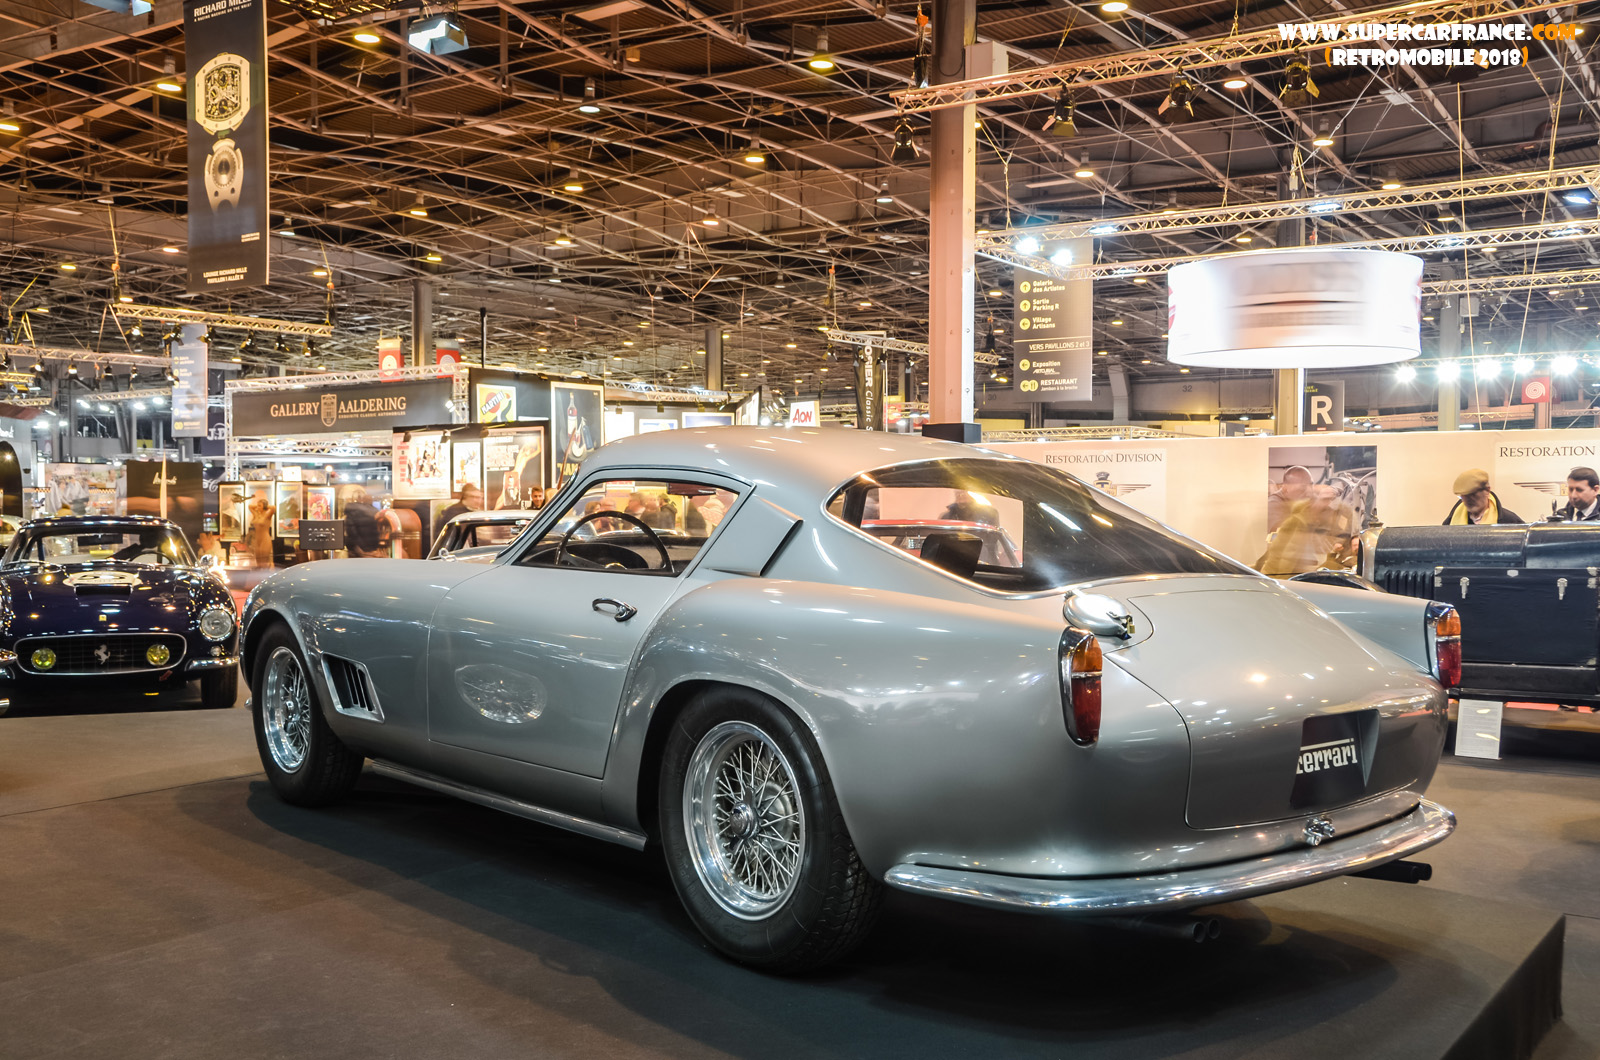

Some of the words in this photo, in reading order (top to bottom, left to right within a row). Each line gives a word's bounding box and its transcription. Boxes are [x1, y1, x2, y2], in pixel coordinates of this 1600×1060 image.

[194, 0, 227, 17] RICHARD
[1029, 343, 1044, 351] VERS
[1045, 341, 1074, 350] PAVILLONS
[1040, 378, 1078, 386] RESTAURANT
[1182, 384, 1193, 393] 32
[270, 402, 320, 418] GALLERY
[338, 396, 407, 413] AALDERING
[866, 390, 874, 422] Classic
[1311, 395, 1334, 425] R
